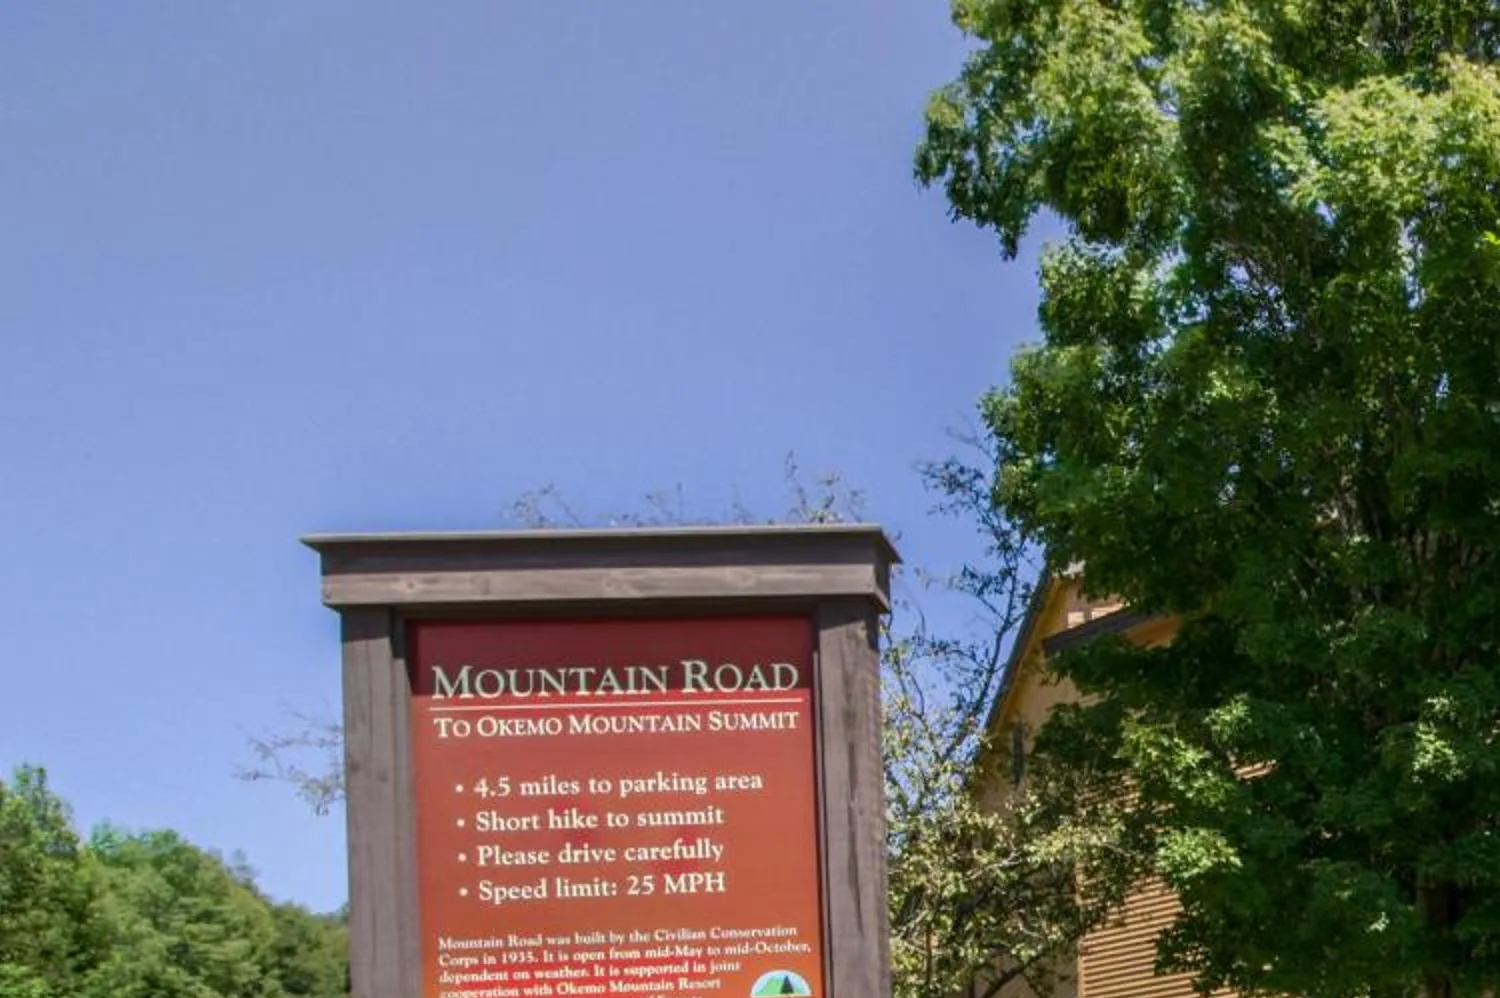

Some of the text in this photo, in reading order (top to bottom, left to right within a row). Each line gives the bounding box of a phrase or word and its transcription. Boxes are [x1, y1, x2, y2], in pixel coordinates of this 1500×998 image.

[431, 660, 799, 699] MOUNTAIN ROAD
[433, 711, 799, 738] TO OKEMO MOUNTAIN SUMMIT
[474, 771, 764, 798] 4.5 miles to parking area
[476, 805, 725, 831] Short hike to summit
[476, 838, 724, 867] Please drive carefully
[479, 872, 726, 905] Speed limit: 25 MPH
[438, 926, 797, 950] Mountain Road was built by the Civilian Conservation
[439, 953, 479, 968] Corps
[483, 951, 497, 965] in
[543, 950, 555, 963] It
[558, 949, 569, 962] is
[573, 950, 605, 964] open
[609, 947, 641, 960] from
[645, 943, 703, 959] mid-May
[707, 944, 721, 956] to
[440, 967, 508, 984] dependent
[513, 970, 530, 980] on
[594, 964, 605, 977] It
[609, 964, 620, 977] is
[623, 961, 689, 978] supported
[693, 960, 706, 972] in
[710, 961, 741, 975] joint
[523, 982, 553, 996] with
[557, 981, 605, 995] Okemo
[609, 978, 674, 993] Mountain
[679, 976, 721, 990] Resort
